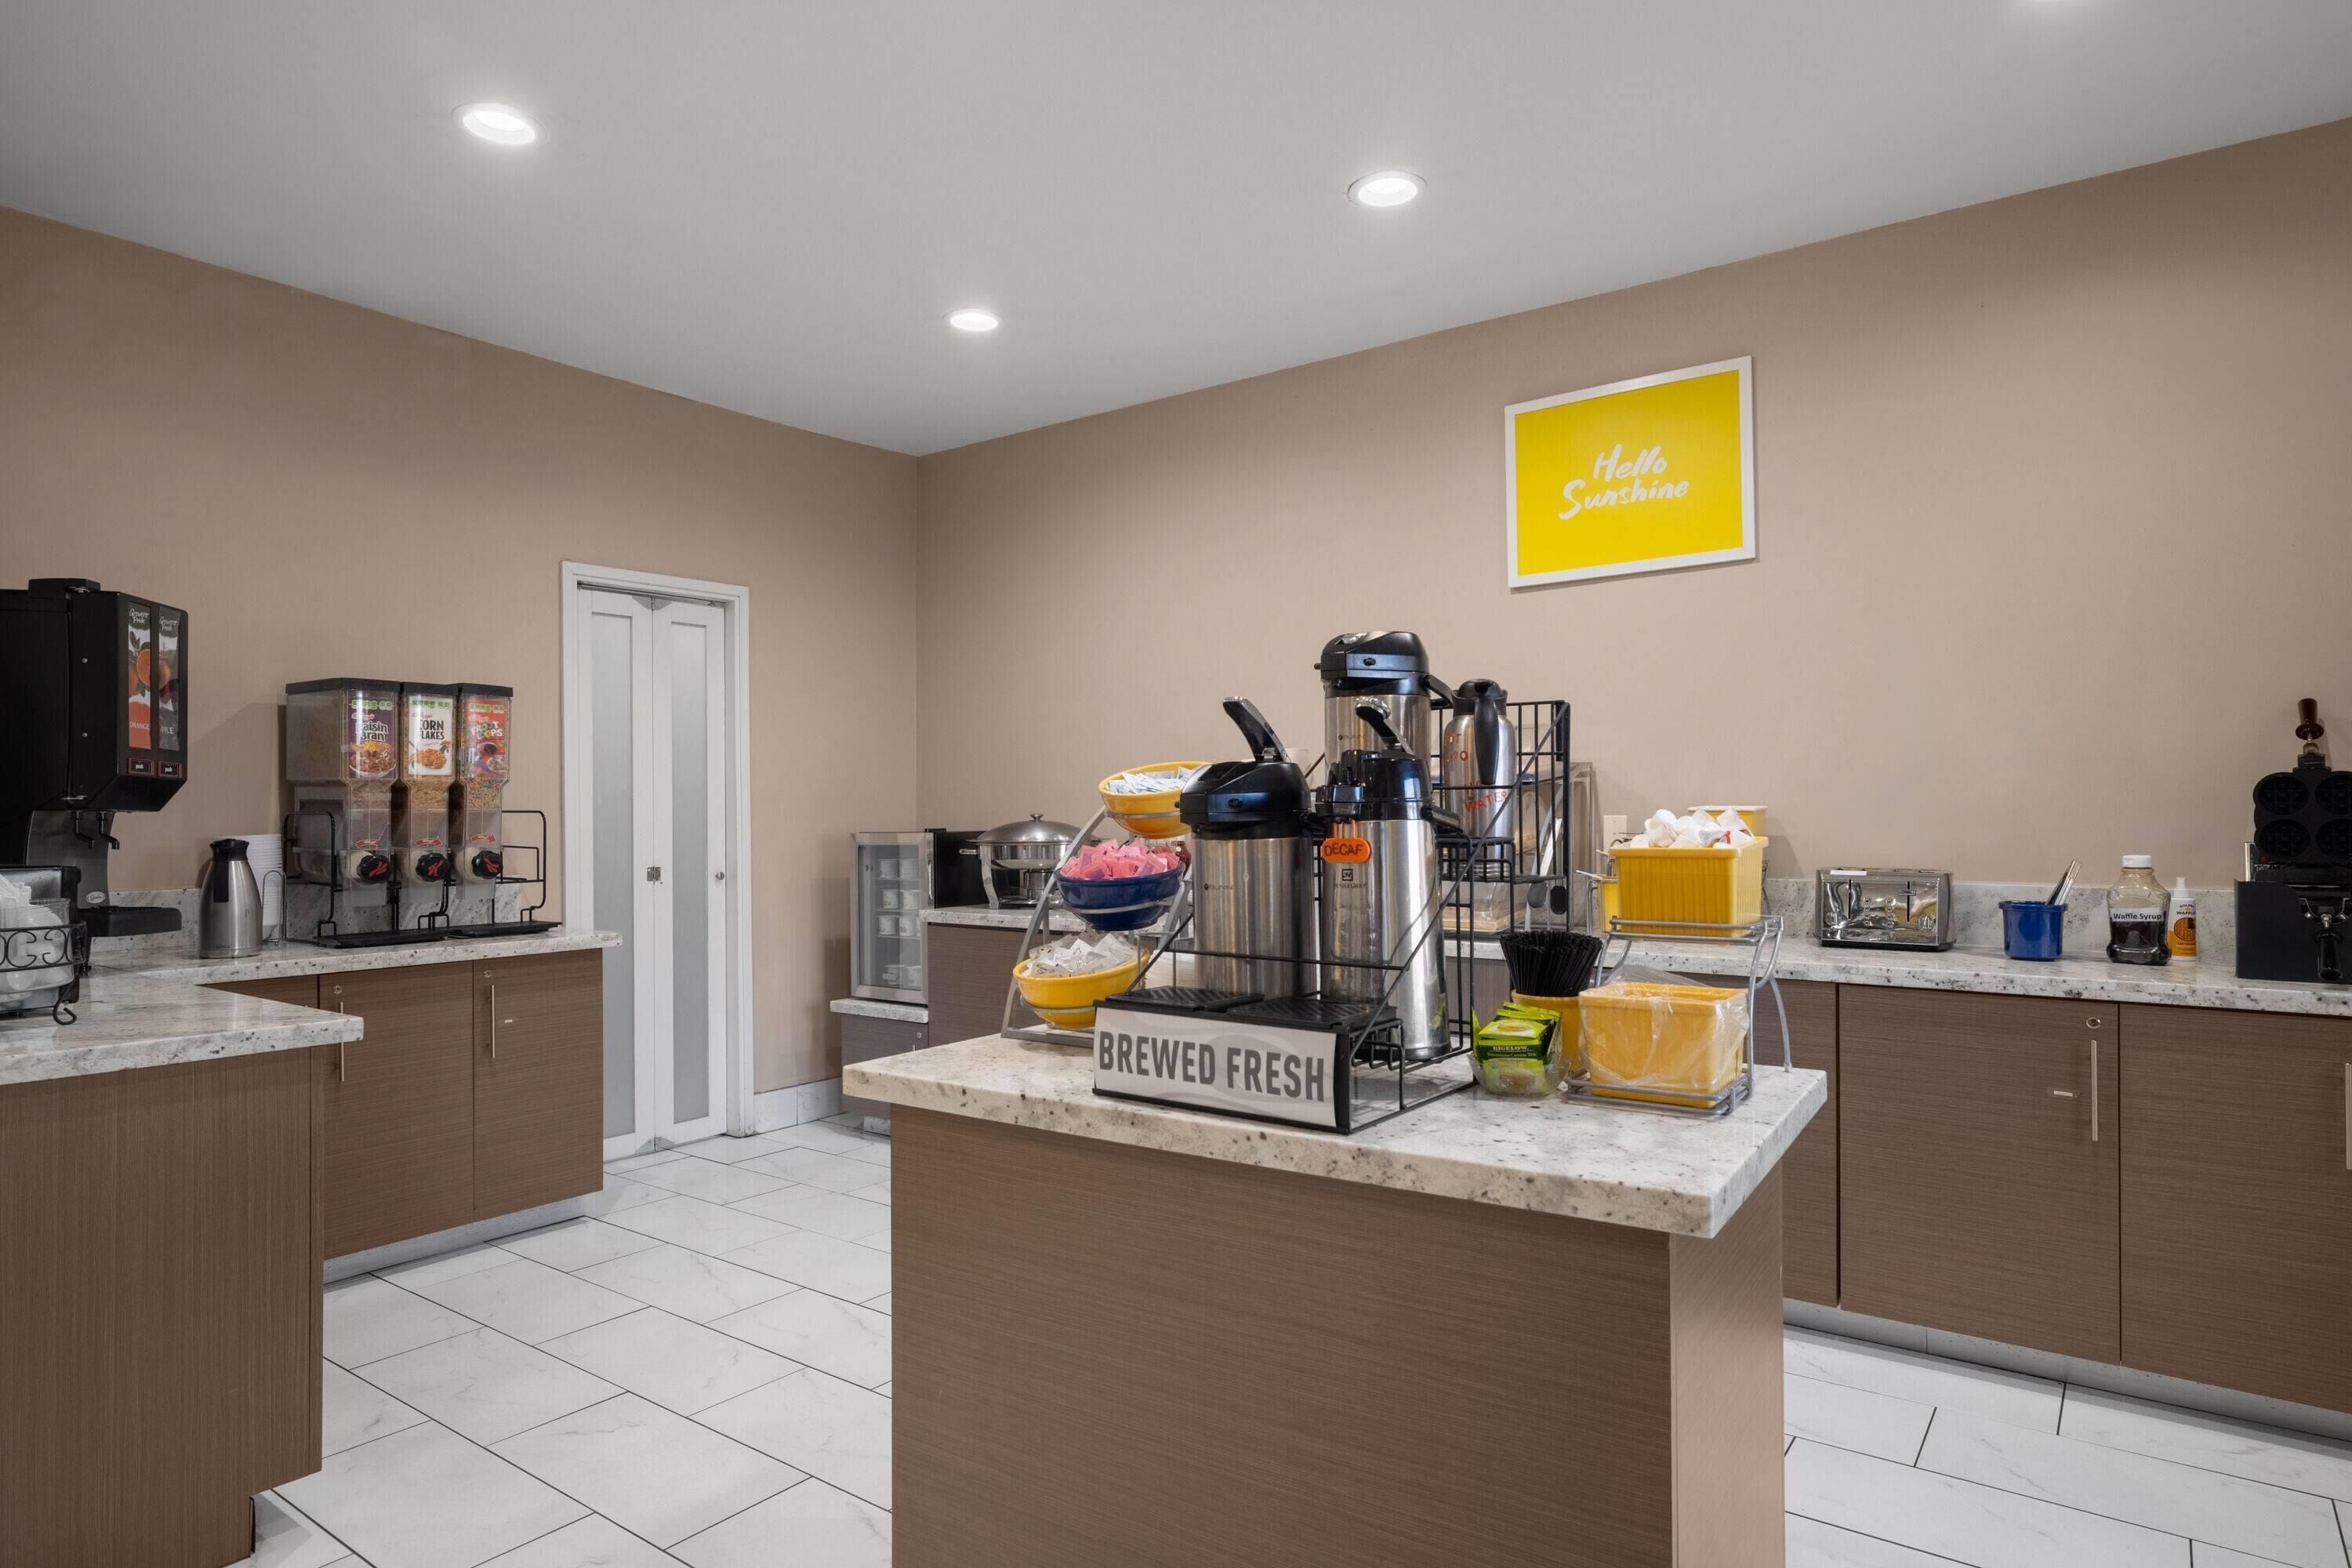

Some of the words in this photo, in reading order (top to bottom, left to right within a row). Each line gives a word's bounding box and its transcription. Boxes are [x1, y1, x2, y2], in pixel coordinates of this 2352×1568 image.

[1592, 444, 1668, 481] Hello
[1558, 479, 1690, 520] Sunshine
[129, 721, 150, 730] ORANGE
[419, 731, 445, 740] LAKES
[1465, 791, 1508, 812] WATER
[1324, 842, 1363, 857] DECAF
[2140, 913, 2162, 921] Syrup
[1099, 1031, 1215, 1085] BREWED
[1226, 1047, 1324, 1102] FRESH
